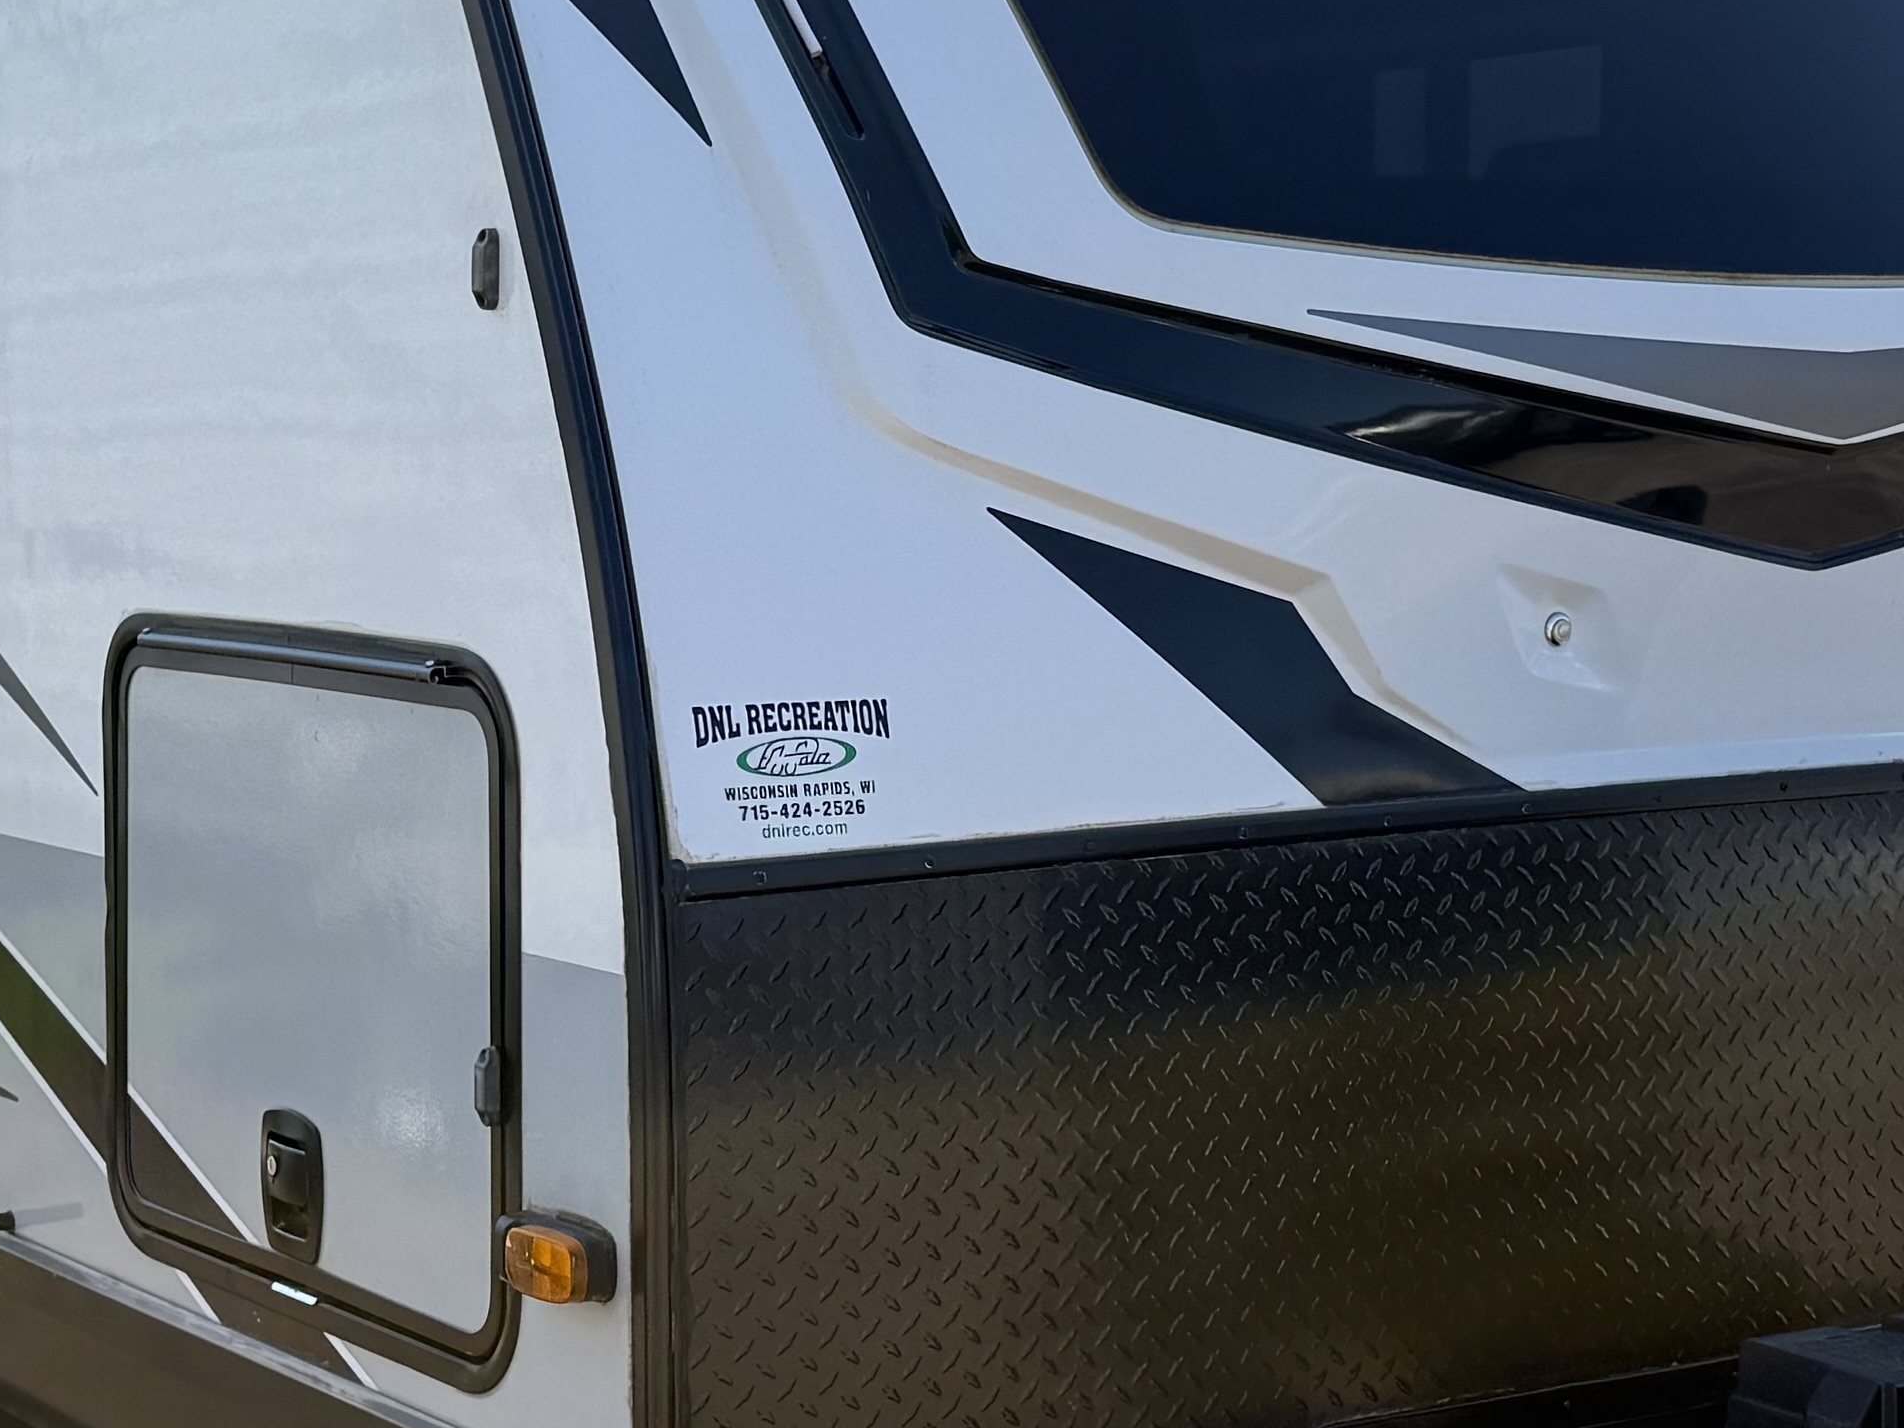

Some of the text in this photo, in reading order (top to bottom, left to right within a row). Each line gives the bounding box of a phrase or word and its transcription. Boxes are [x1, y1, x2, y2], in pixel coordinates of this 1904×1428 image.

[692, 698, 890, 748] DNL RECREATION
[724, 780, 876, 801] WISCONSIN RAPIDS, WI
[739, 799, 866, 821] 715-424-2526
[762, 821, 848, 839] dnlrec.com
